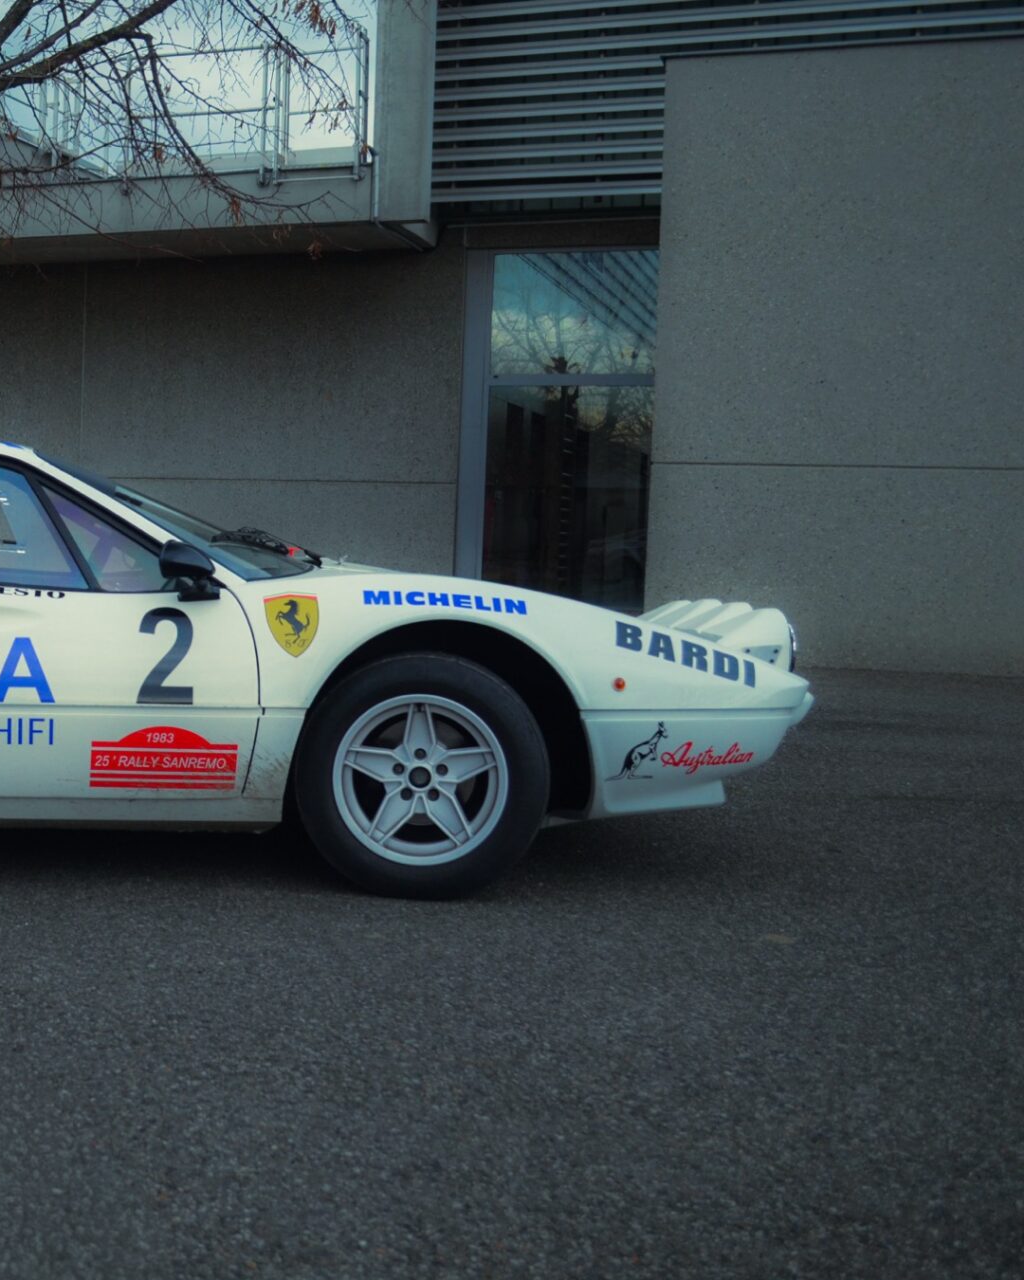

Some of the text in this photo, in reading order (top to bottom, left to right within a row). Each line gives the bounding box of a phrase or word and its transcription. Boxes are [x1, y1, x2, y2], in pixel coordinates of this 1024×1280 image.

[362, 588, 529, 616] MICHELIN
[136, 606, 194, 706] 2
[614, 620, 757, 689] BARDI
[145, 732, 175, 745] 1983
[117, 755, 160, 768] RALLY
[161, 757, 227, 770] SANREMO
[660, 741, 756, 775] Australian
